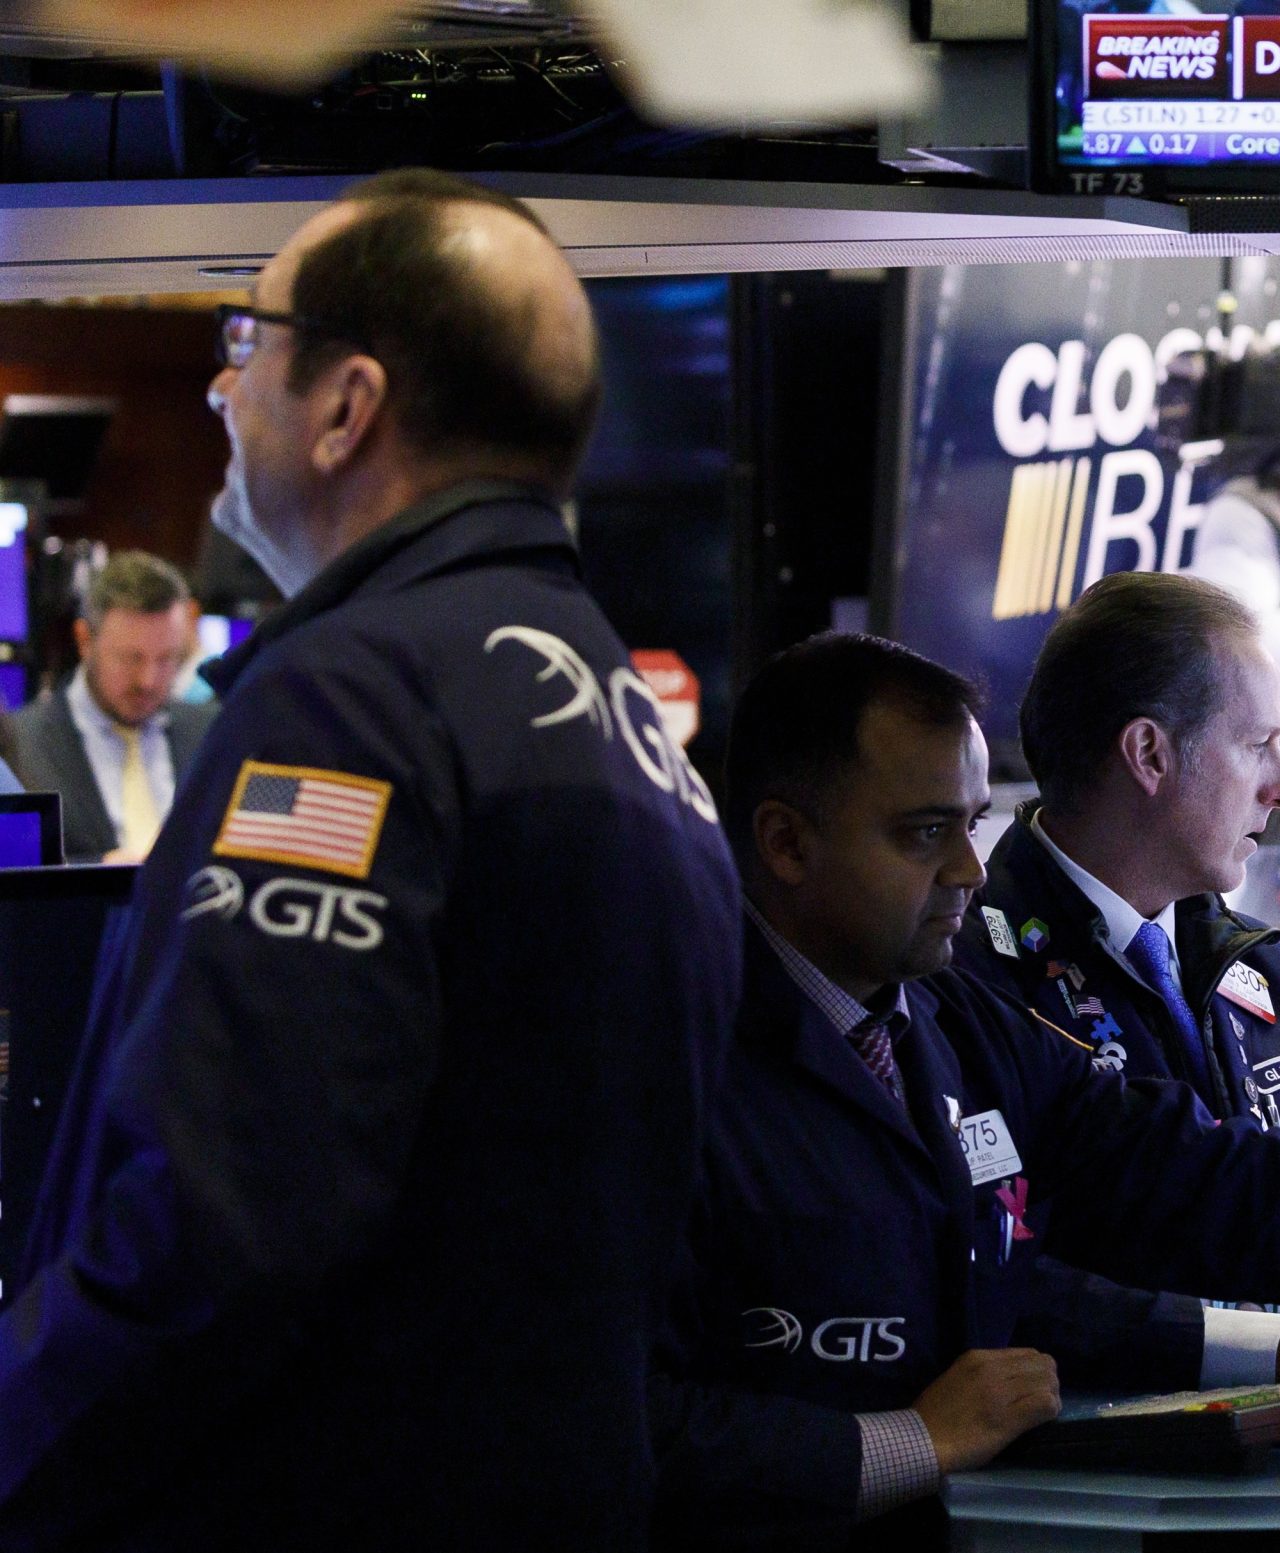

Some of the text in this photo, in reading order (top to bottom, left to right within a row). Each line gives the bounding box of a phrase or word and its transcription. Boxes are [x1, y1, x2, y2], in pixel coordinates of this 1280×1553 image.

[1097, 36, 1220, 57] BREAKING
[1126, 55, 1217, 80] NEWS
[1197, 106, 1240, 124] 1.27
[1149, 133, 1199, 155] 0.17
[1225, 133, 1280, 155] Core
[1071, 172, 1145, 194] TF 73
[249, 877, 389, 951] GTS
[986, 915, 1003, 945] 3979
[811, 1317, 906, 1362] GTS
